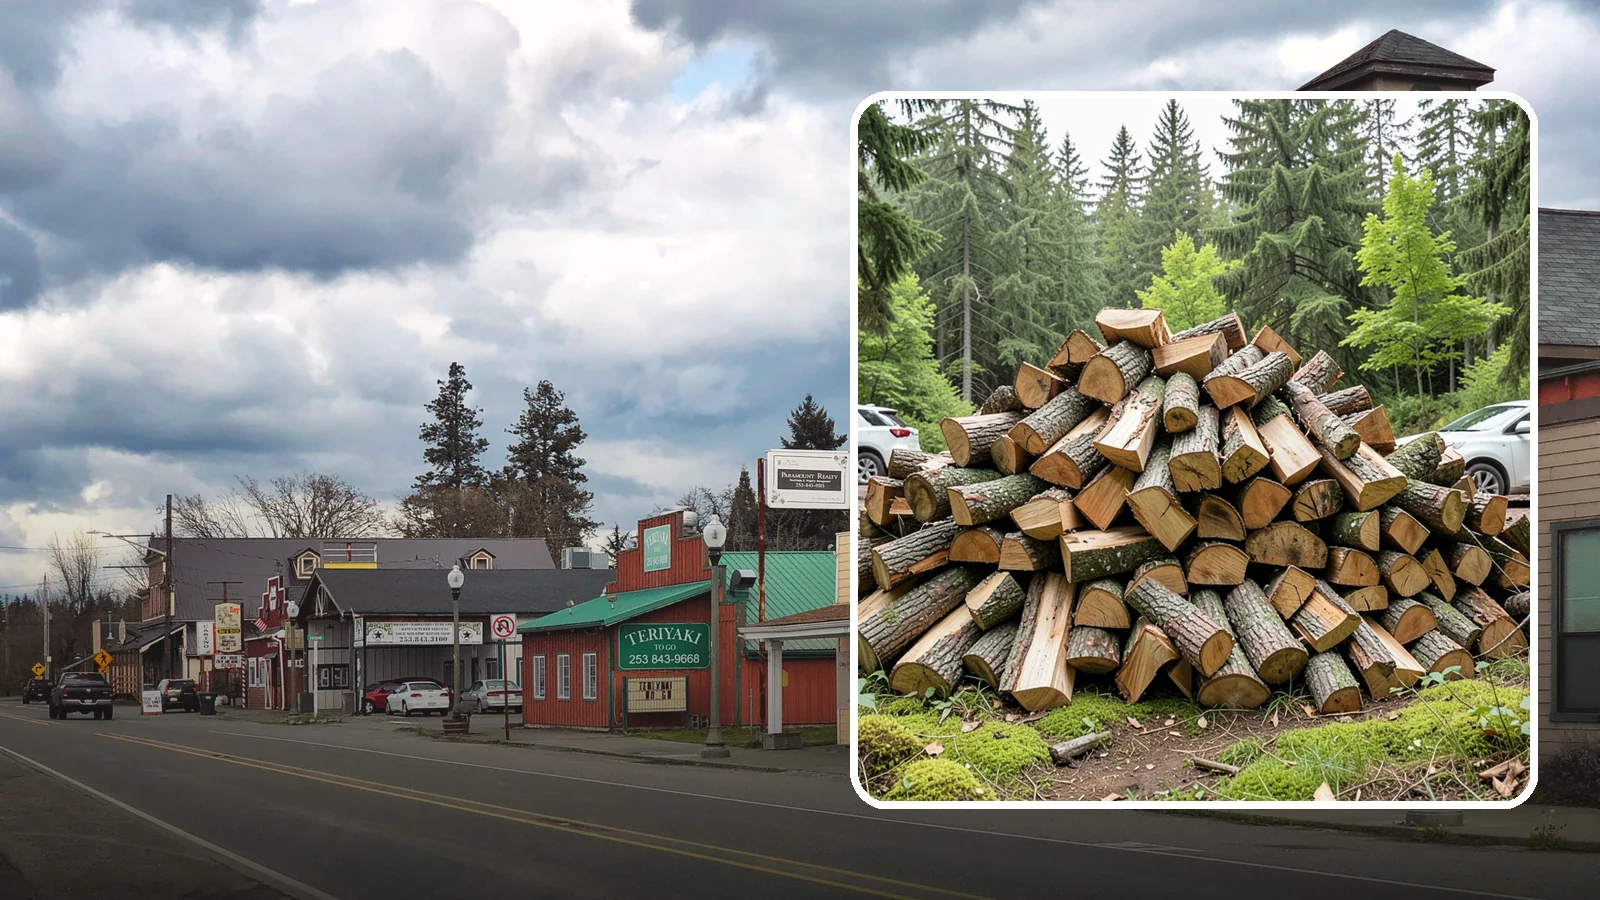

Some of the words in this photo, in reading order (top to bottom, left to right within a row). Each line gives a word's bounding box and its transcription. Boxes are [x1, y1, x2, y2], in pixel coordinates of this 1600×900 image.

[624, 627, 702, 646] TERIYAKI
[628, 654, 648, 665] 253
[651, 653, 700, 664] 843-9668
